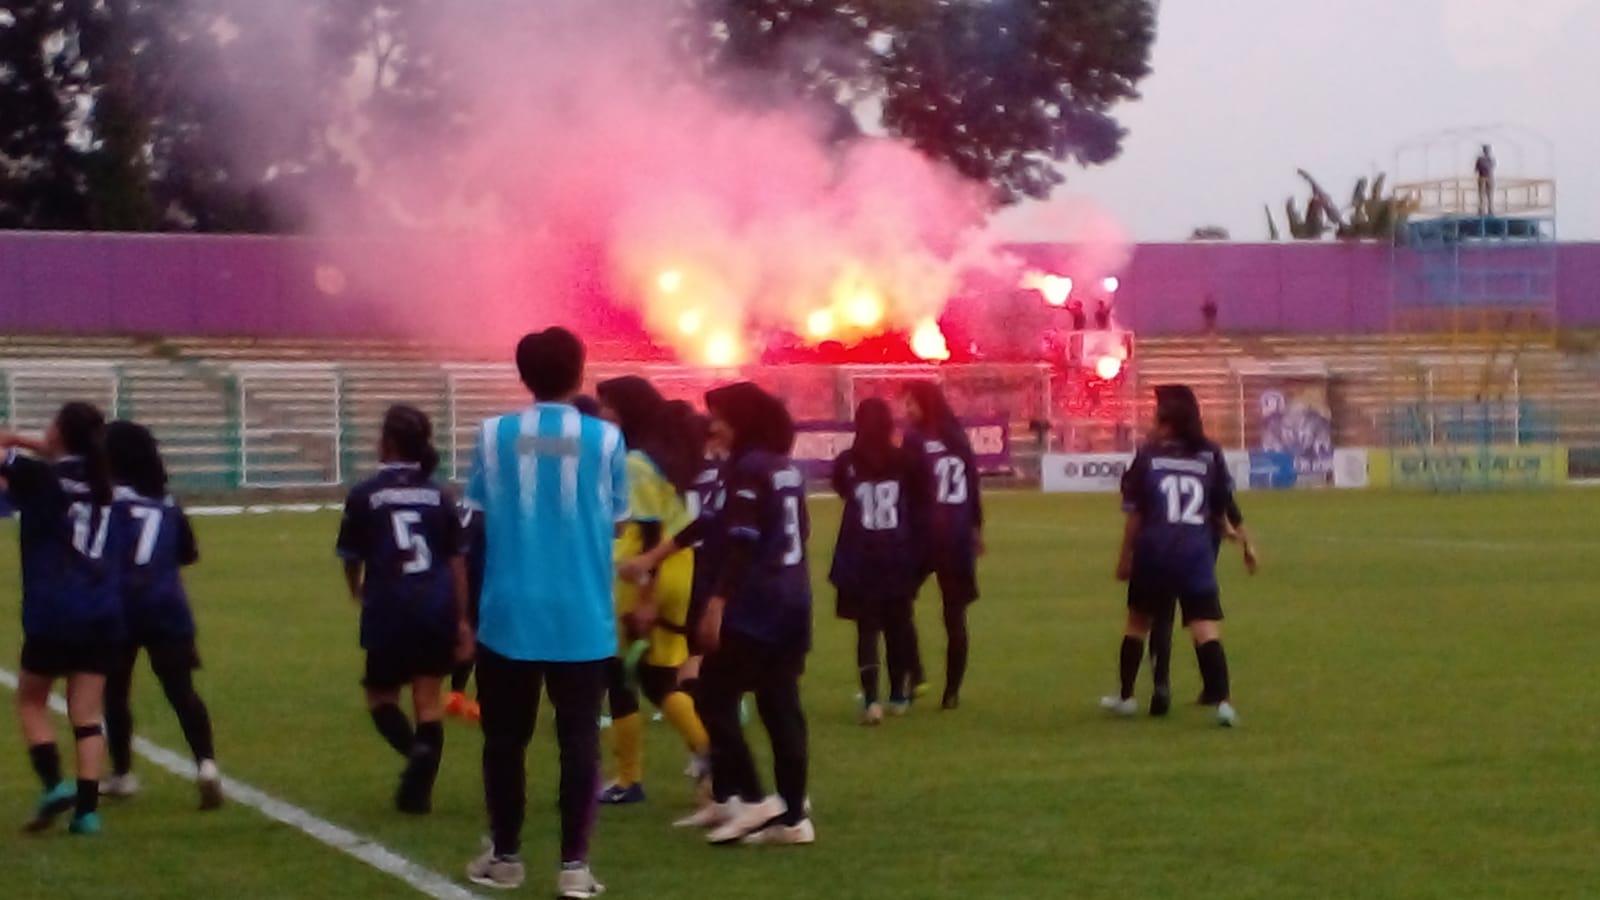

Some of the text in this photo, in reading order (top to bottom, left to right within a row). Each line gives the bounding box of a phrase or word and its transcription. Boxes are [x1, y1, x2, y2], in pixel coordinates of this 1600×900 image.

[855, 481, 900, 530] 18
[1160, 475, 1205, 525] 12
[131, 505, 163, 566] 7
[391, 510, 432, 574] 5
